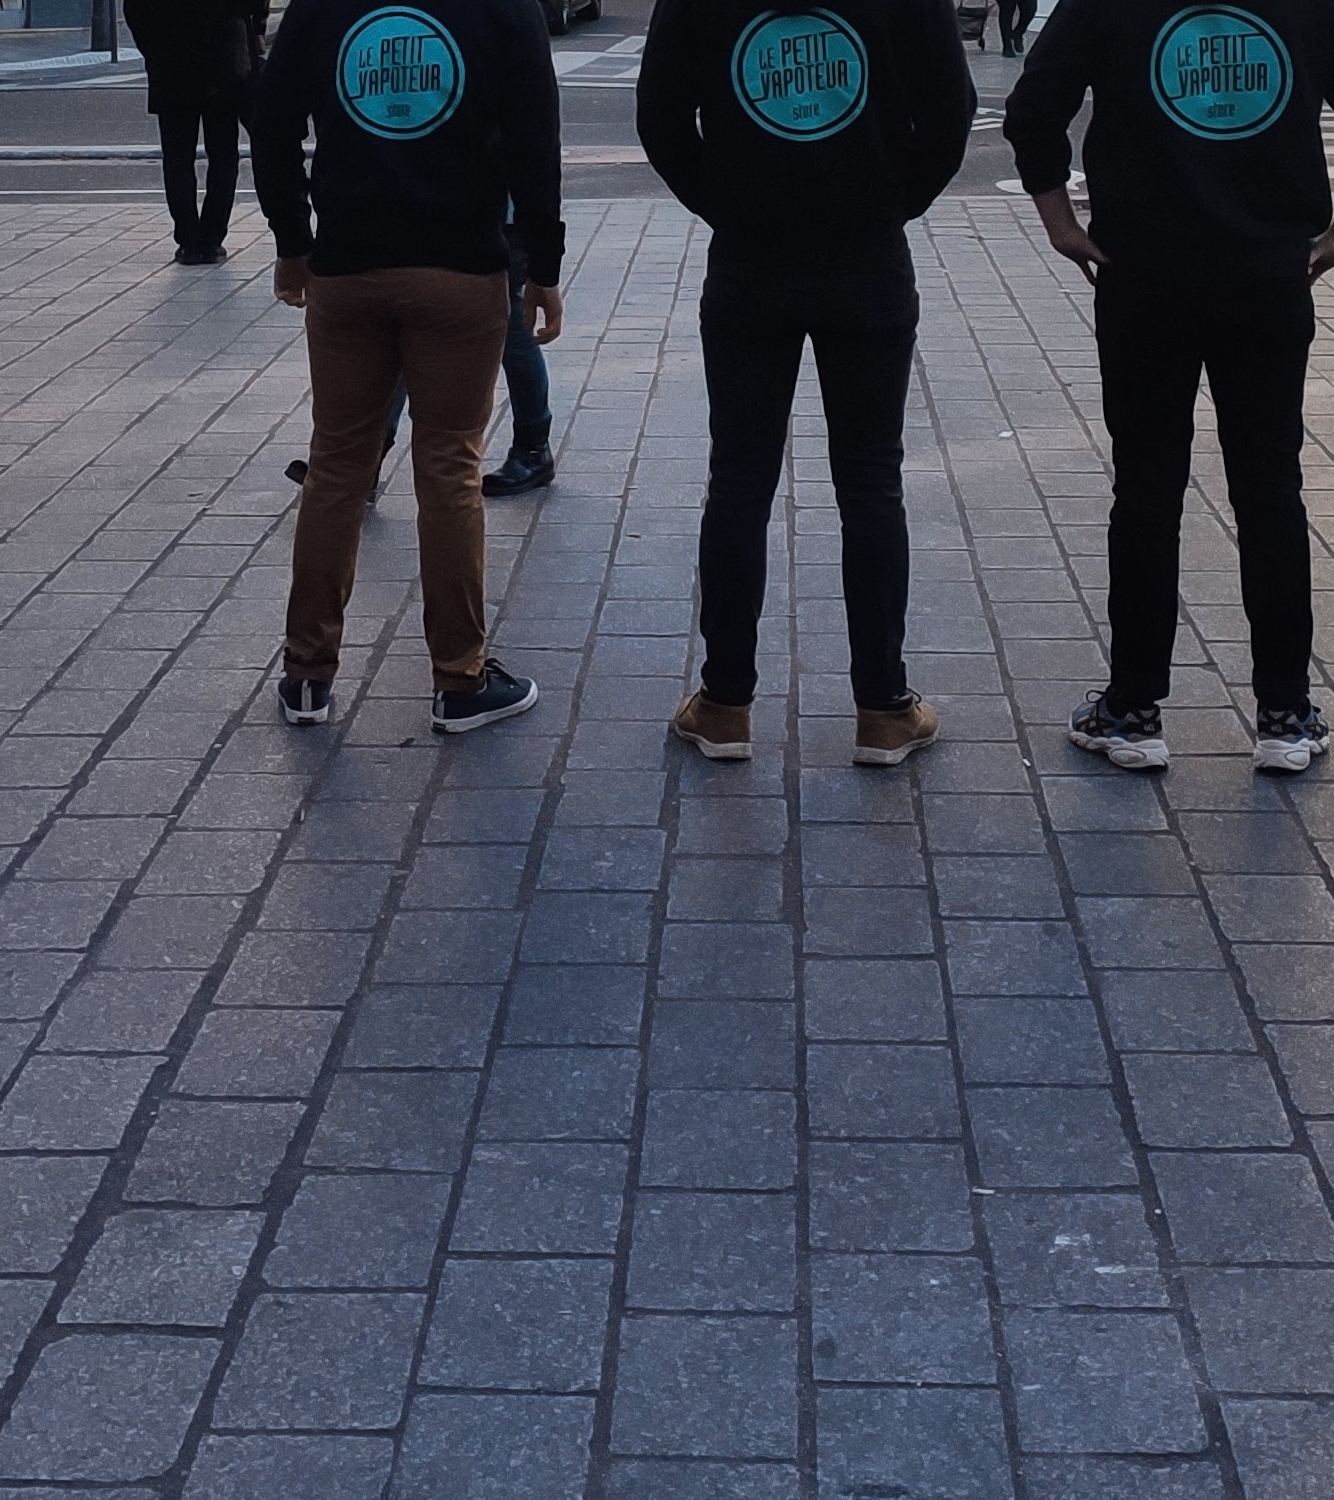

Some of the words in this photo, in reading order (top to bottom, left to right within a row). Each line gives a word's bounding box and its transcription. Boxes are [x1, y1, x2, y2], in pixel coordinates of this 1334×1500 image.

[358, 47, 375, 68] LE
[380, 35, 424, 67] PETIT
[758, 47, 776, 71] LE
[780, 32, 828, 67] PETIT
[1176, 45, 1194, 68] LE
[1198, 34, 1247, 66] PETIT
[358, 63, 441, 97] VAPOTEUR
[760, 59, 848, 99] VAPOTEUR
[1177, 62, 1267, 98] VAPOTEUR
[792, 102, 820, 120] store
